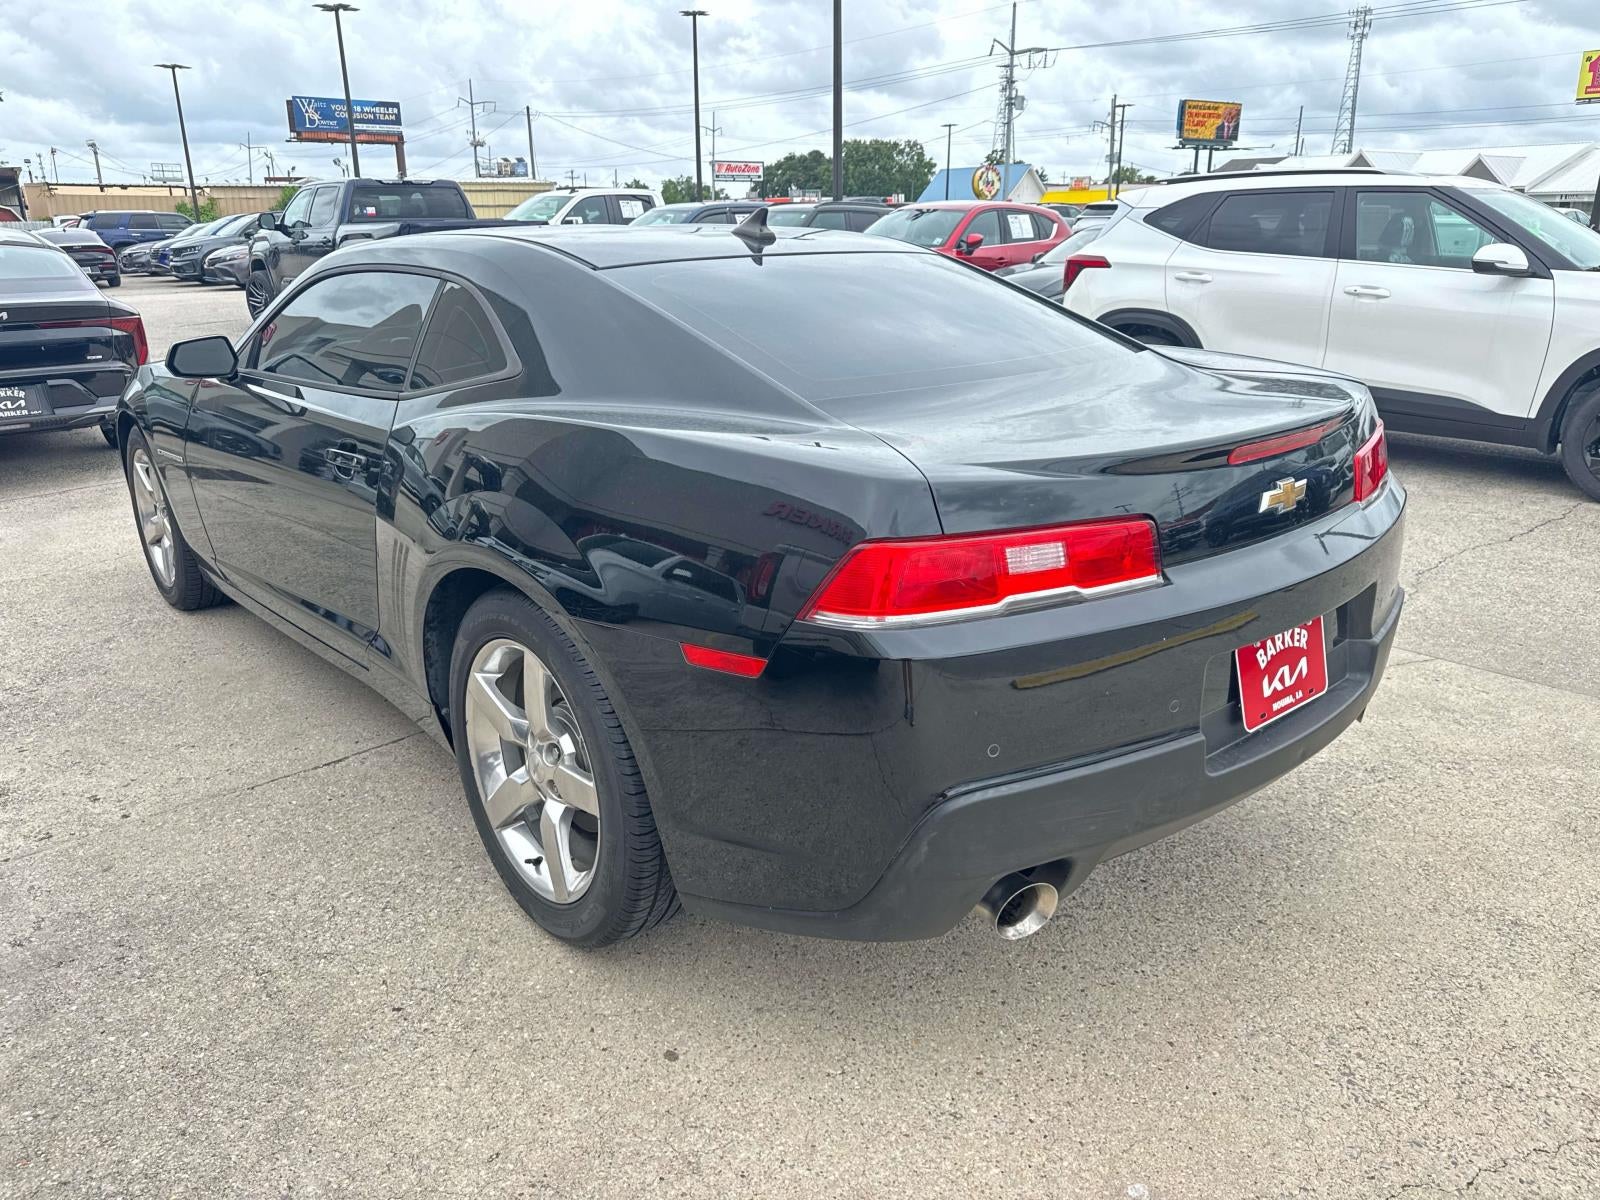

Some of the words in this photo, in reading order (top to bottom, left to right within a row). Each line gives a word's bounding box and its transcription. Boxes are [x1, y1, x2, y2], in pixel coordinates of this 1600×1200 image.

[331, 104, 348, 112] YOU
[363, 106, 398, 114] WHEELER
[335, 111, 374, 120] COLISION
[724, 164, 760, 174] AutoZone
[1255, 627, 1309, 670] BARKER
[1262, 655, 1308, 698] KIA
